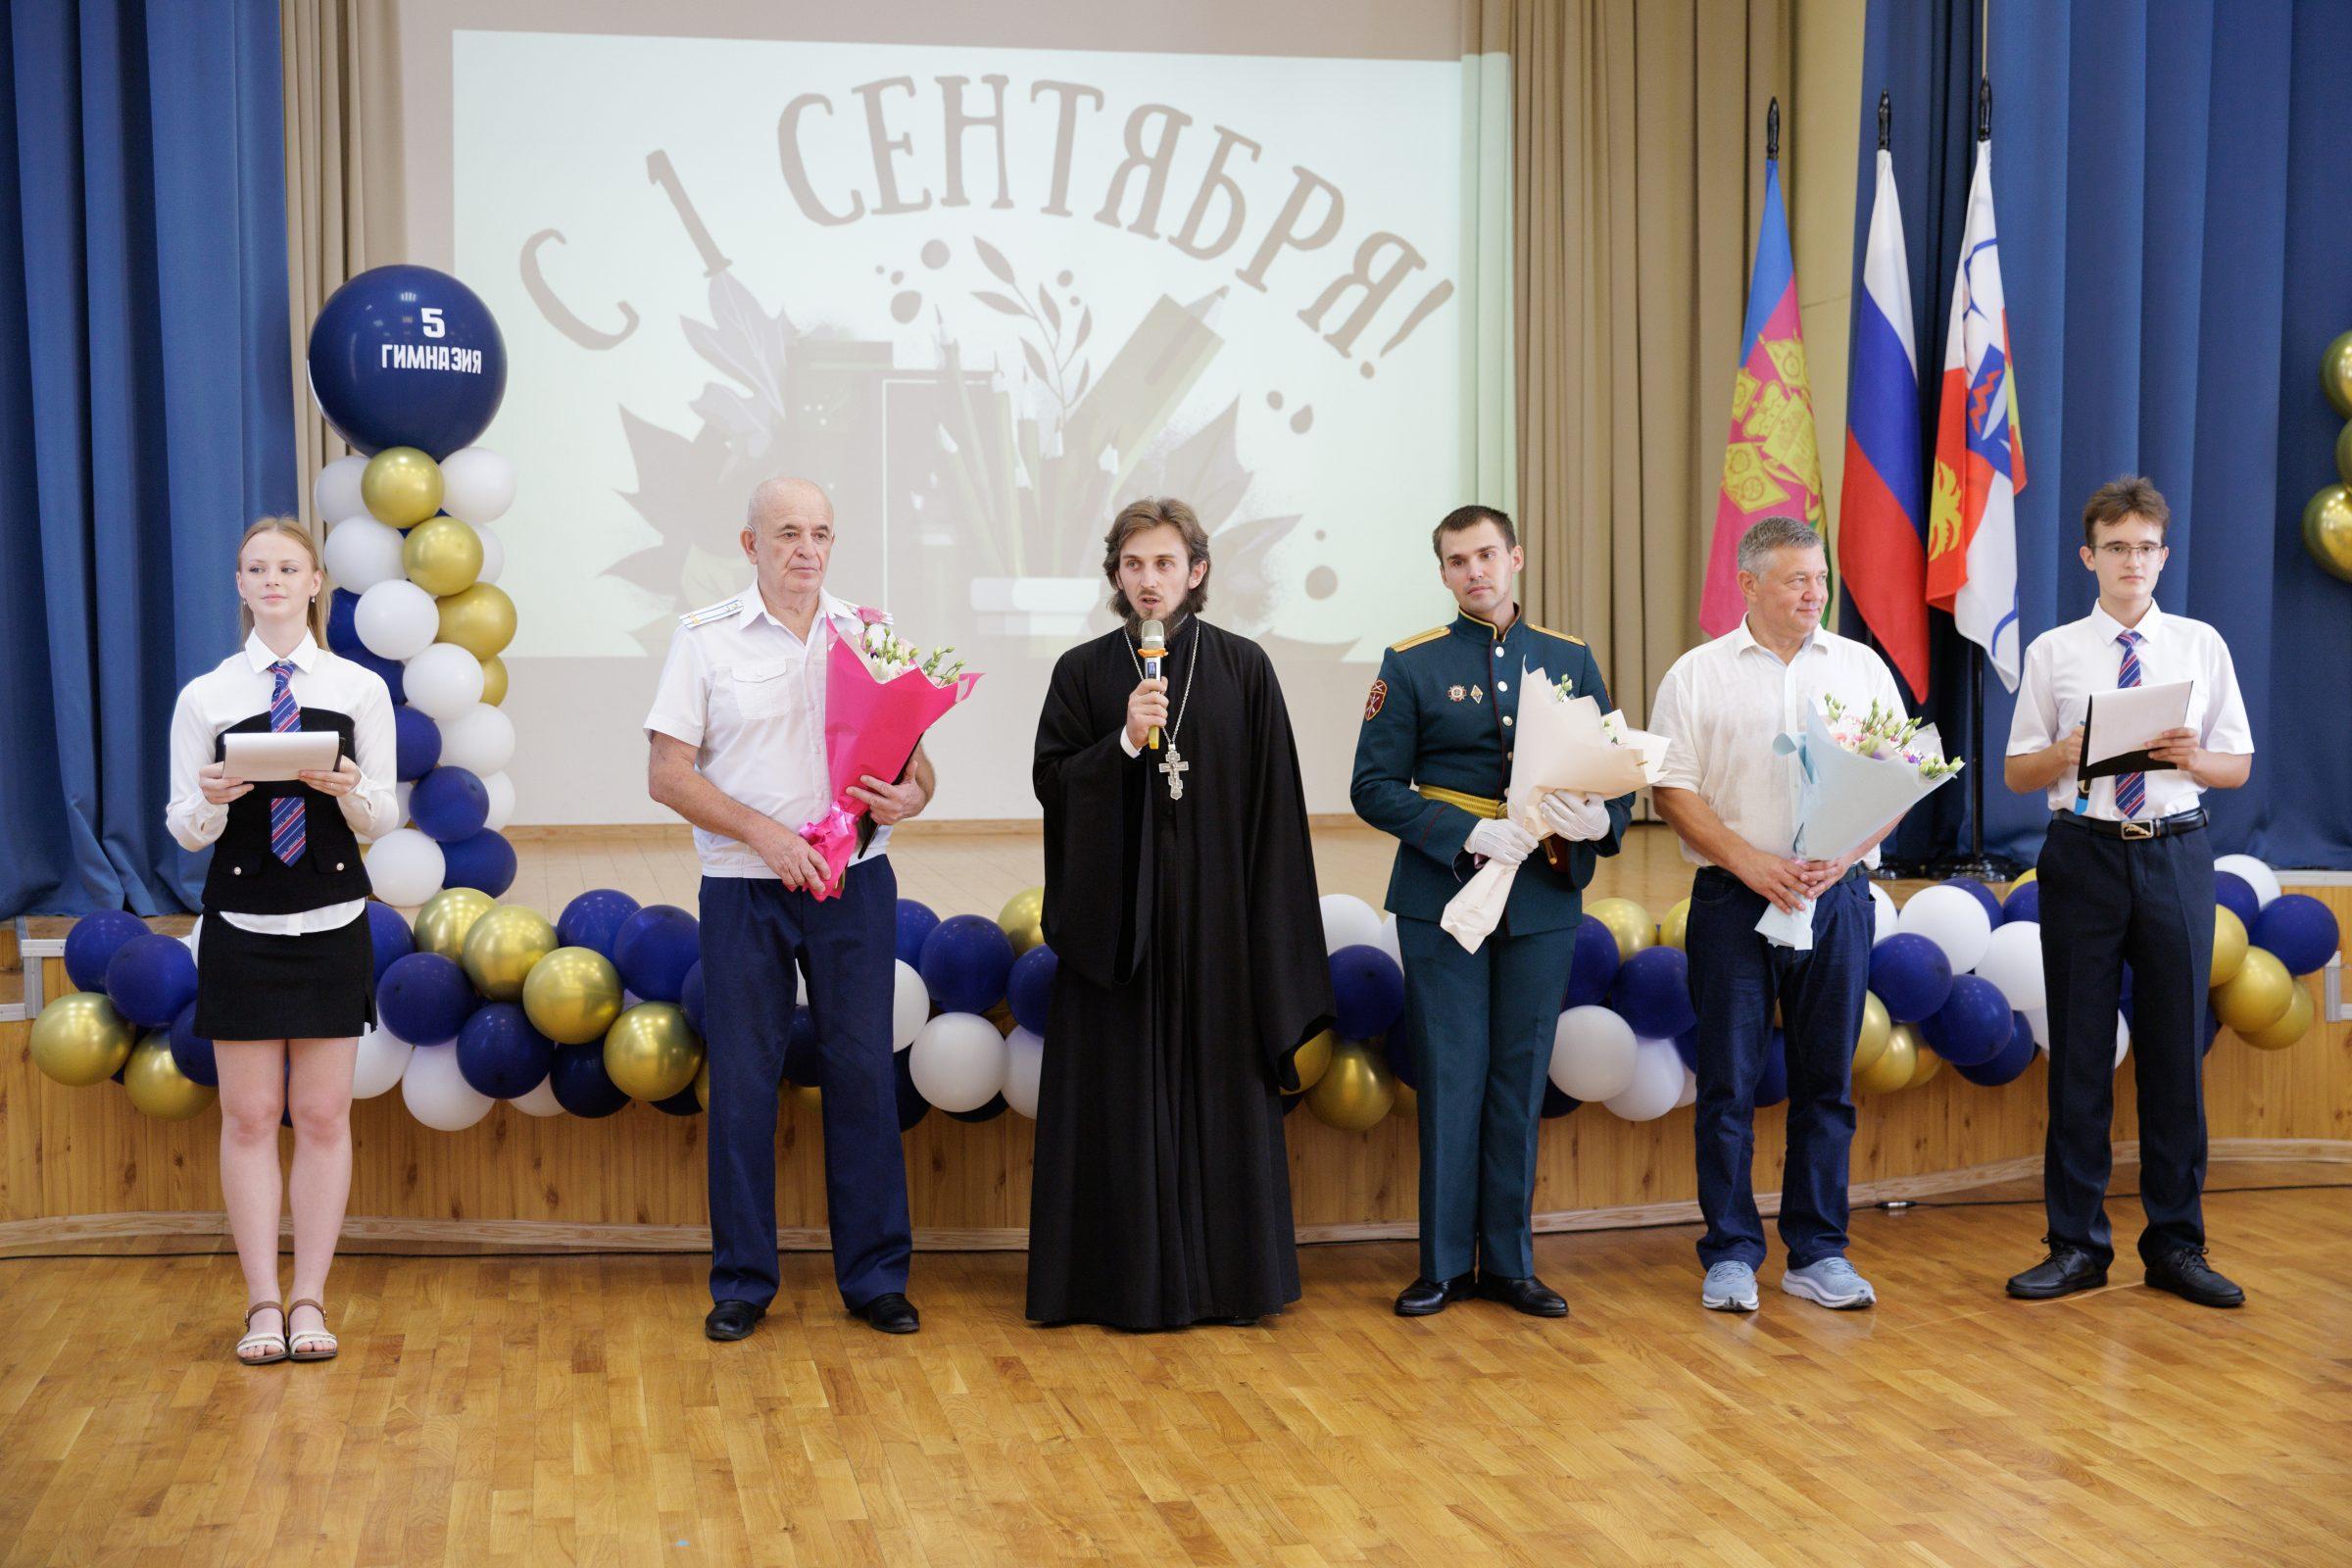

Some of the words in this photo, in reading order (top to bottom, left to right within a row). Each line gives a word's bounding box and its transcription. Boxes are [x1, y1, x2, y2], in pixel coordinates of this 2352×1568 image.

[520, 229, 639, 350] С
[647, 150, 731, 277] 1
[778, 74, 1454, 378] СЕНТЯБРЯ!
[420, 307, 446, 339] 5
[381, 344, 482, 374] ГИМНАЗИЯ
